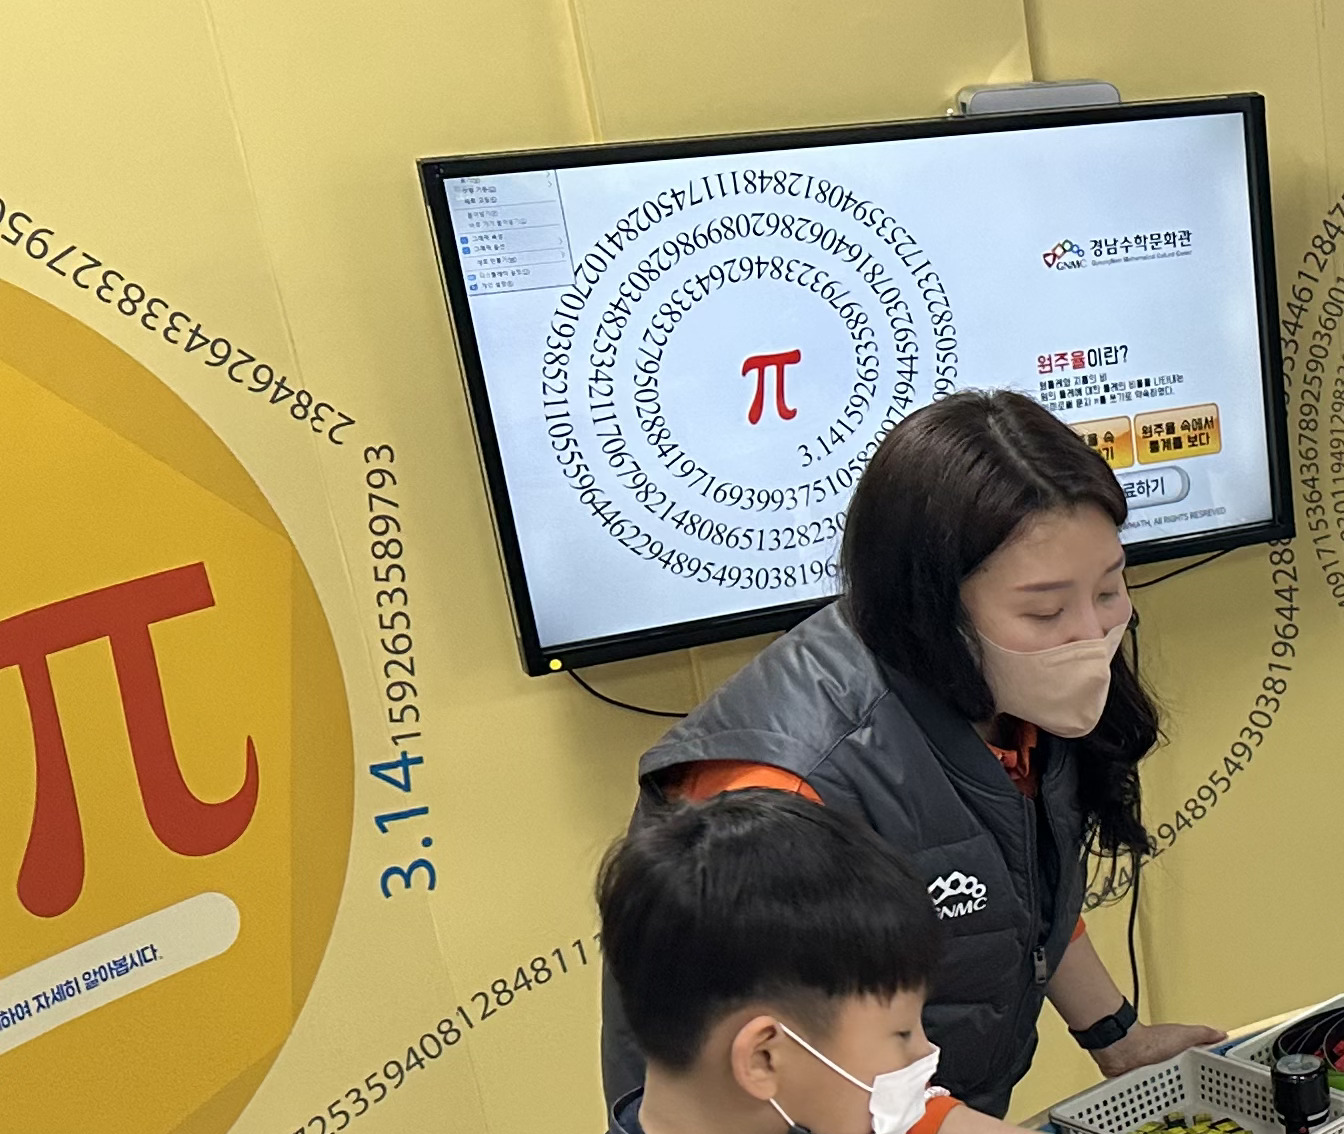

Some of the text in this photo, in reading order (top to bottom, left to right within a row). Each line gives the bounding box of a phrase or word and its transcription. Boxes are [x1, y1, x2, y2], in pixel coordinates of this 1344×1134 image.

[1089, 229, 1193, 258] 경남수학문화관
[1037, 345, 1129, 374] 원주율이란?
[1141, 416, 1215, 439] 원주율 속에서
[1187, 433, 1211, 447] 보다
[935, 896, 988, 920] NMC
[32, 976, 82, 1014] 자세히
[82, 944, 164, 991] 알아봅시다.
